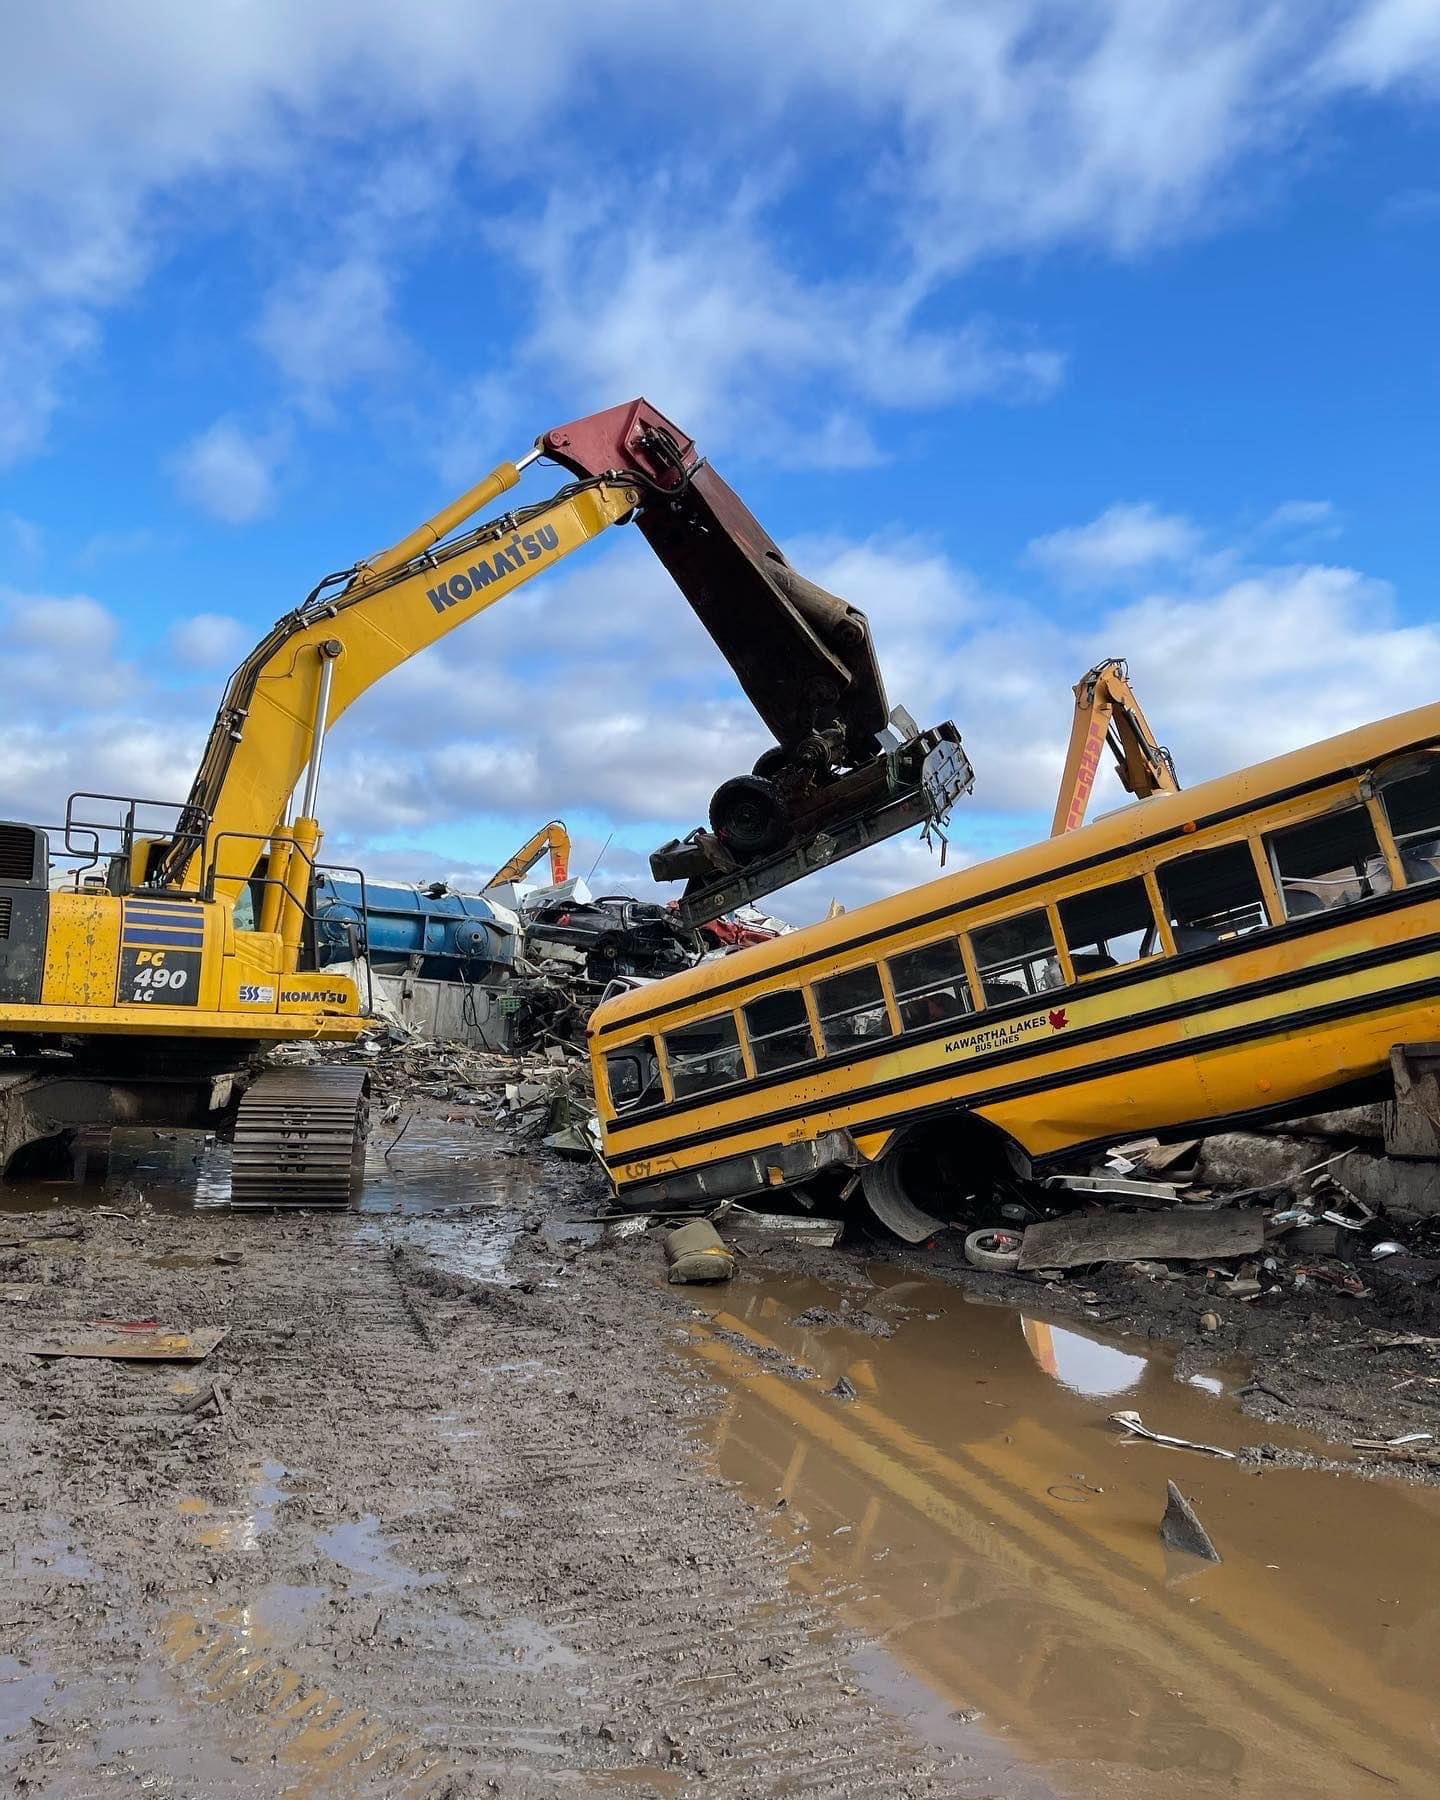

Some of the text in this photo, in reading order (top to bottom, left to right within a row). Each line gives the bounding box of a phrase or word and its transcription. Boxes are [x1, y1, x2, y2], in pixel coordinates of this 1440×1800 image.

[426, 524, 559, 614] KOMATSU
[136, 951, 165, 966] PC
[133, 968, 187, 989] 490
[133, 989, 154, 1001] LC
[281, 989, 347, 1004] KOMATSU
[945, 1016, 1046, 1053] KAWARTHA LAKES
[975, 1034, 1020, 1053] BUS LINES
